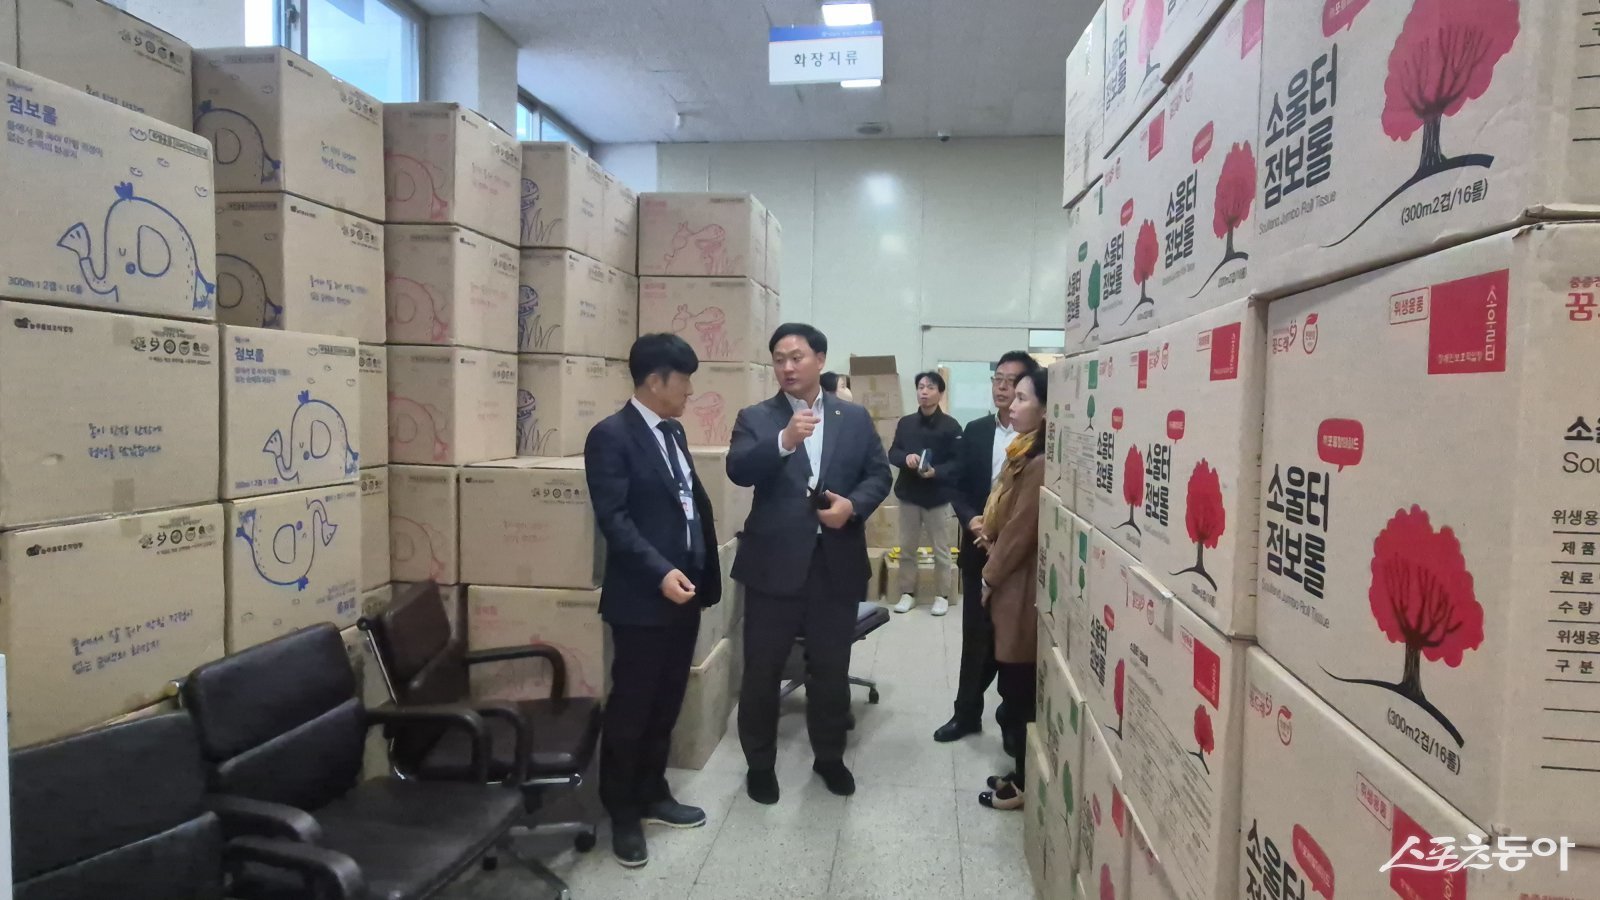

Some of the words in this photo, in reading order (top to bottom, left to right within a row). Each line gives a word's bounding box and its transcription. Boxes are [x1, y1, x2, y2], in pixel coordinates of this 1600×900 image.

[794, 50, 857, 68] 화장지류
[8, 93, 57, 126] 점보롤
[1265, 43, 1337, 148] 소울터
[1264, 115, 1333, 210] 점보롤
[1166, 169, 1197, 227] 소울터
[1400, 178, 1488, 226] (300m2겹/16롤)
[1104, 231, 1125, 268] 소울터
[1165, 214, 1195, 270] 점보롤
[1103, 264, 1122, 300] 점보롤
[235, 347, 264, 362] 점보롤
[1097, 432, 1114, 460] 소울터
[1146, 443, 1171, 483] 소울터
[1097, 461, 1113, 493] 점보롤
[1267, 463, 1329, 533] 소울터
[1146, 482, 1169, 526] 점보롤
[1266, 520, 1326, 599] 점보롤
[1387, 707, 1461, 775] (300m2겹/16롤)
